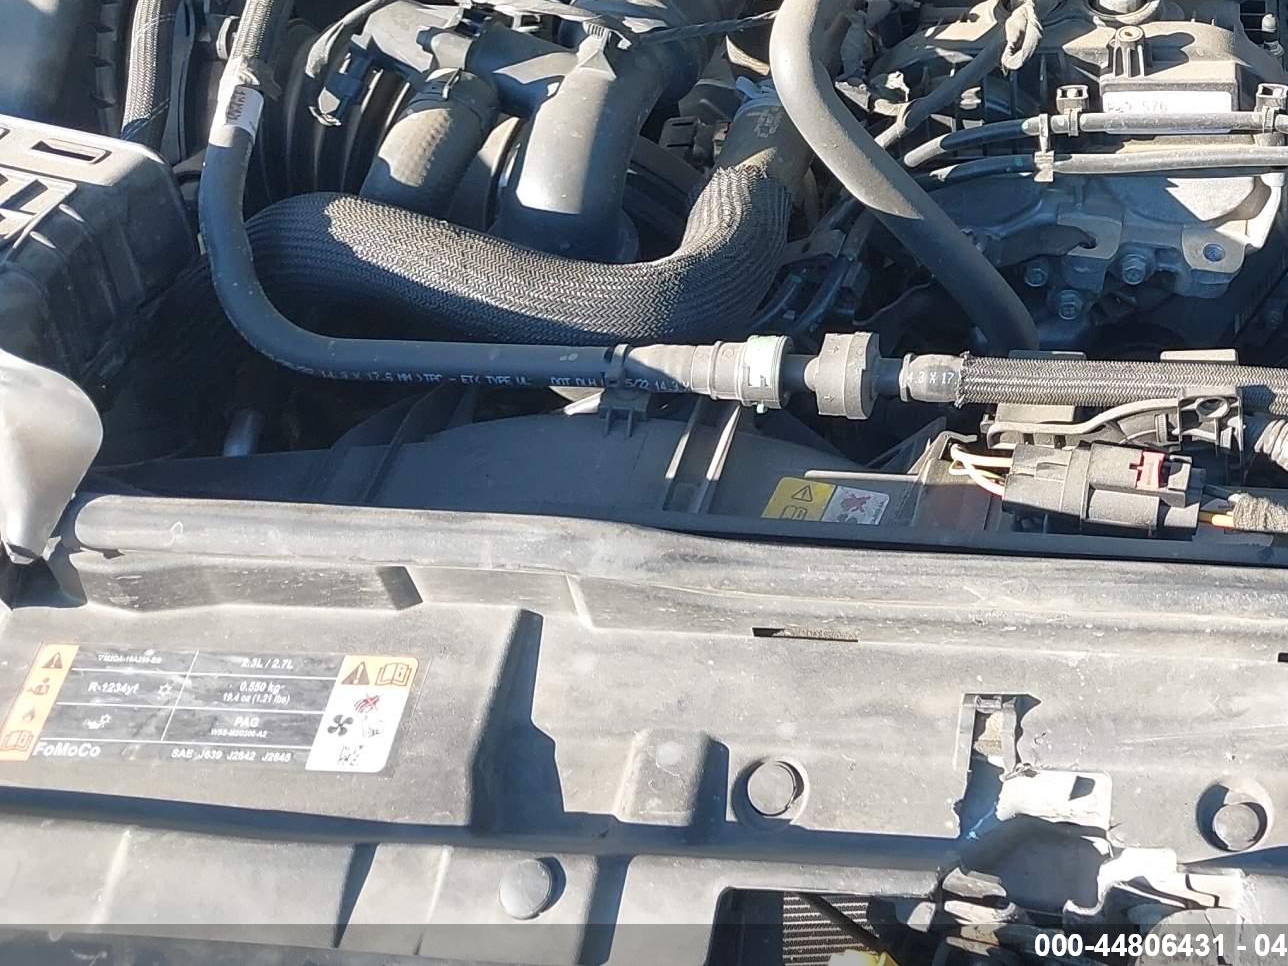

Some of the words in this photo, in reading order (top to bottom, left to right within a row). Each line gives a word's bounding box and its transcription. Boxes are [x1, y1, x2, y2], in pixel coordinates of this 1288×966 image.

[929, 371, 937, 385] X
[241, 657, 263, 669] 2.3L
[271, 658, 294, 670] 2.7L
[233, 716, 260, 728] PAG
[32, 741, 101, 757] FoMoCo
[171, 748, 194, 759] SAE
